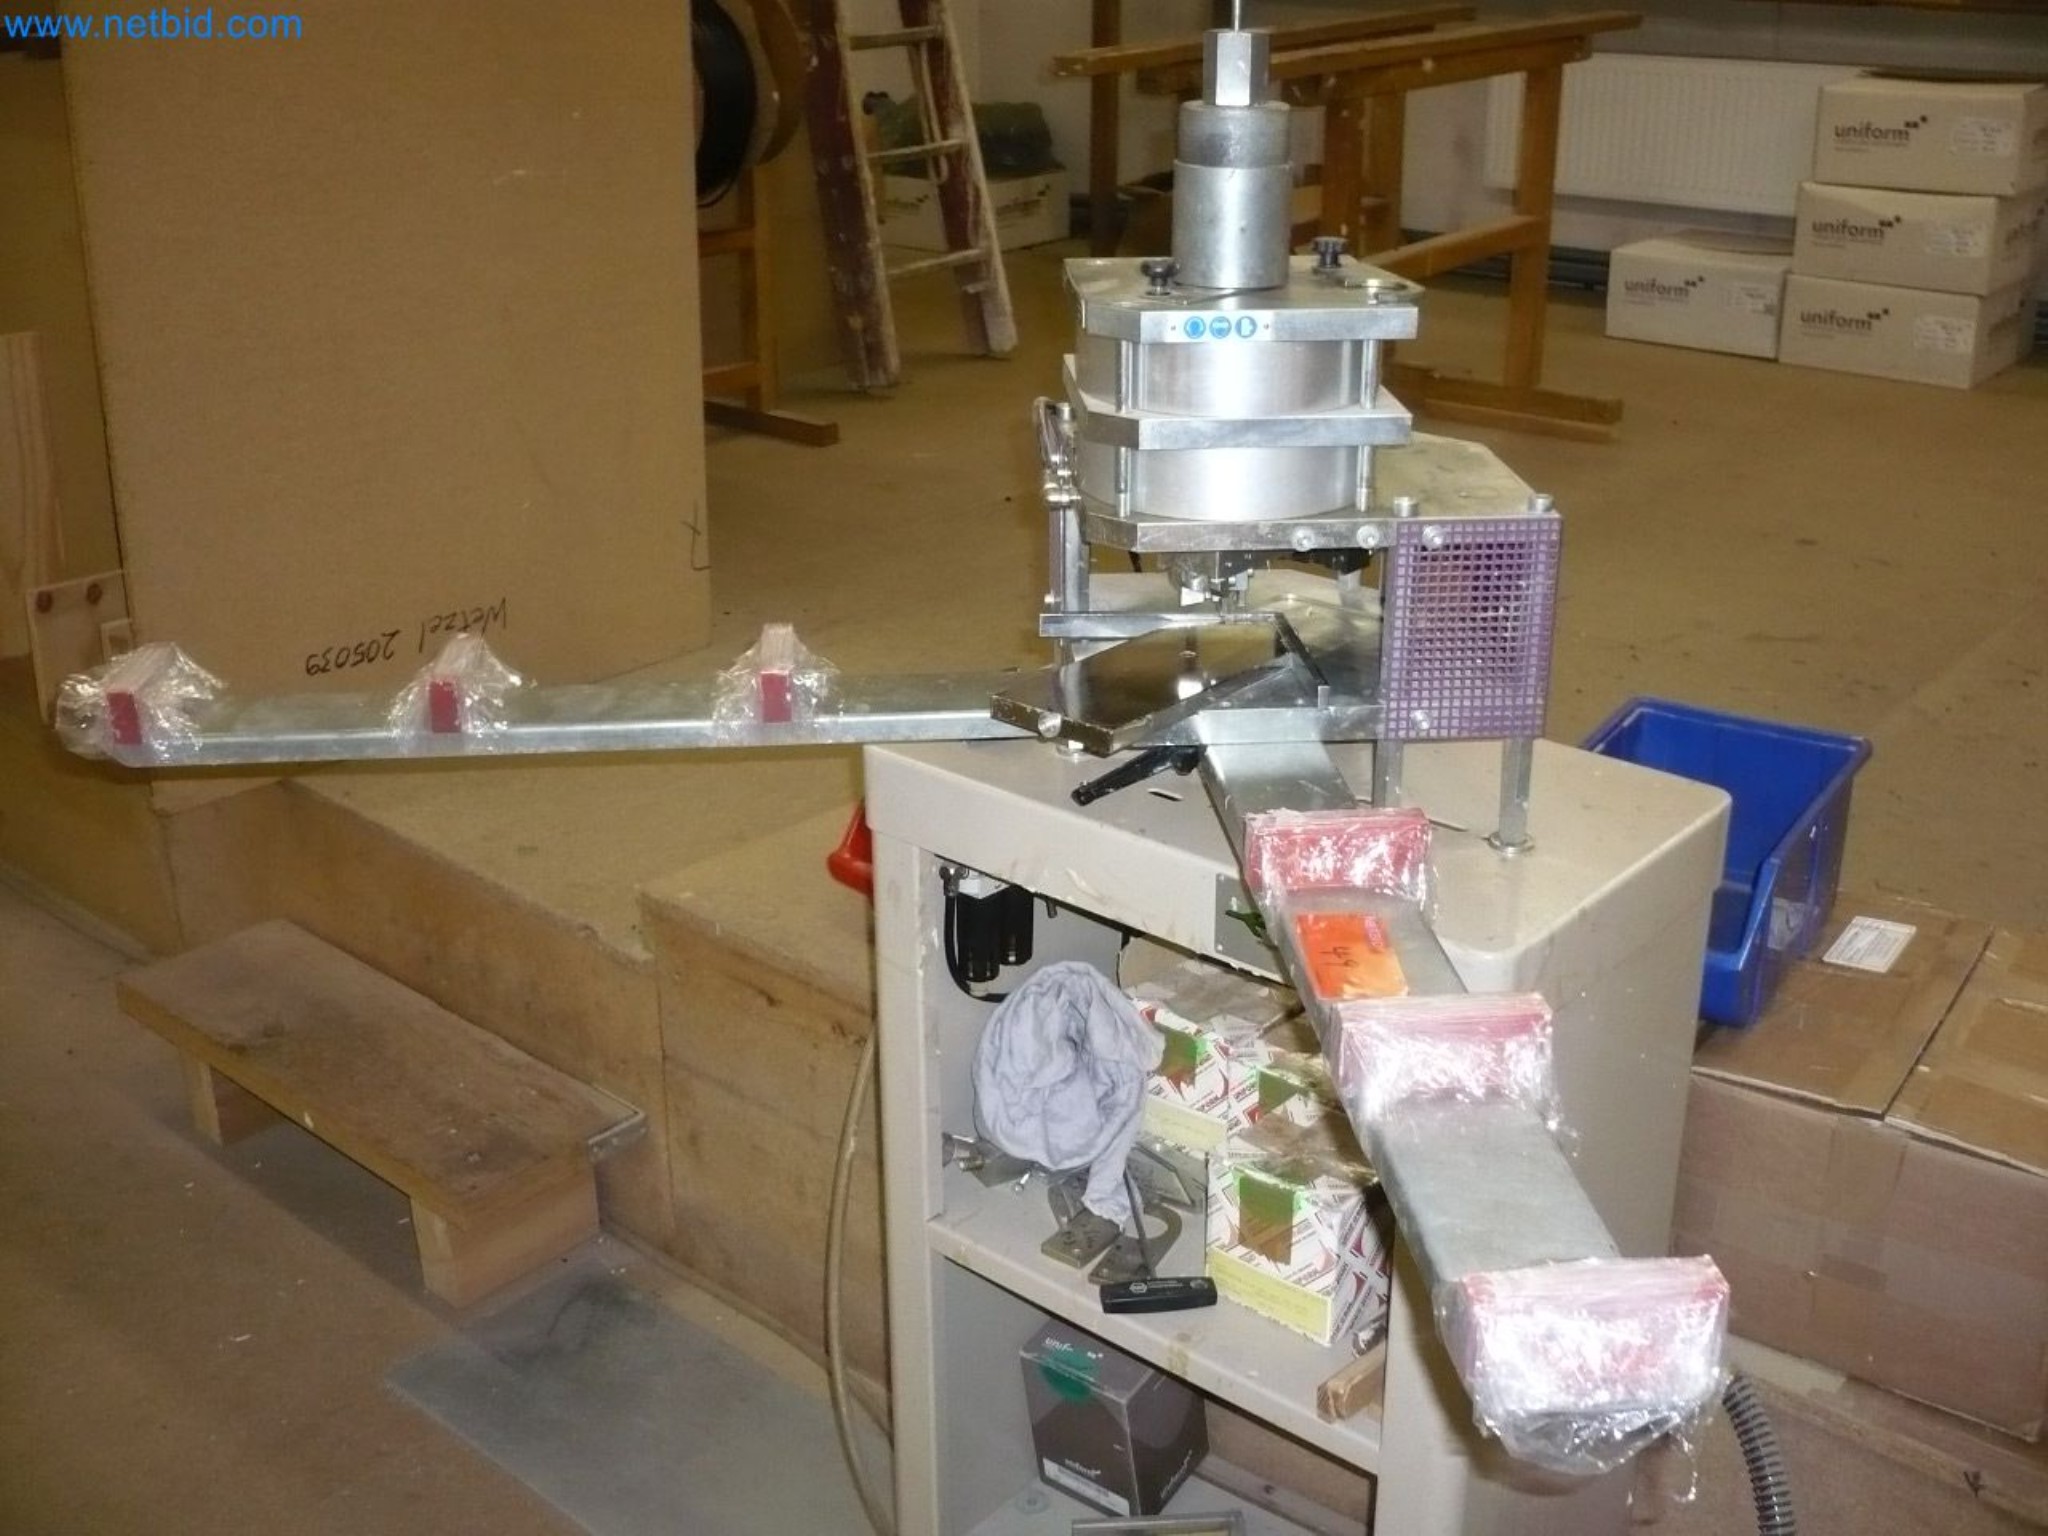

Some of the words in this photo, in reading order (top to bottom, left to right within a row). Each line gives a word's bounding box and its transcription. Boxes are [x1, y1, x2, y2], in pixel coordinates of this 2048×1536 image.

[1834, 120, 1910, 141] uniform
[1812, 218, 1885, 240] uniform
[1624, 277, 1690, 299] uniform
[1800, 309, 1872, 331] uniform
[417, 596, 507, 653] Wetzel
[305, 628, 400, 676] 205039
